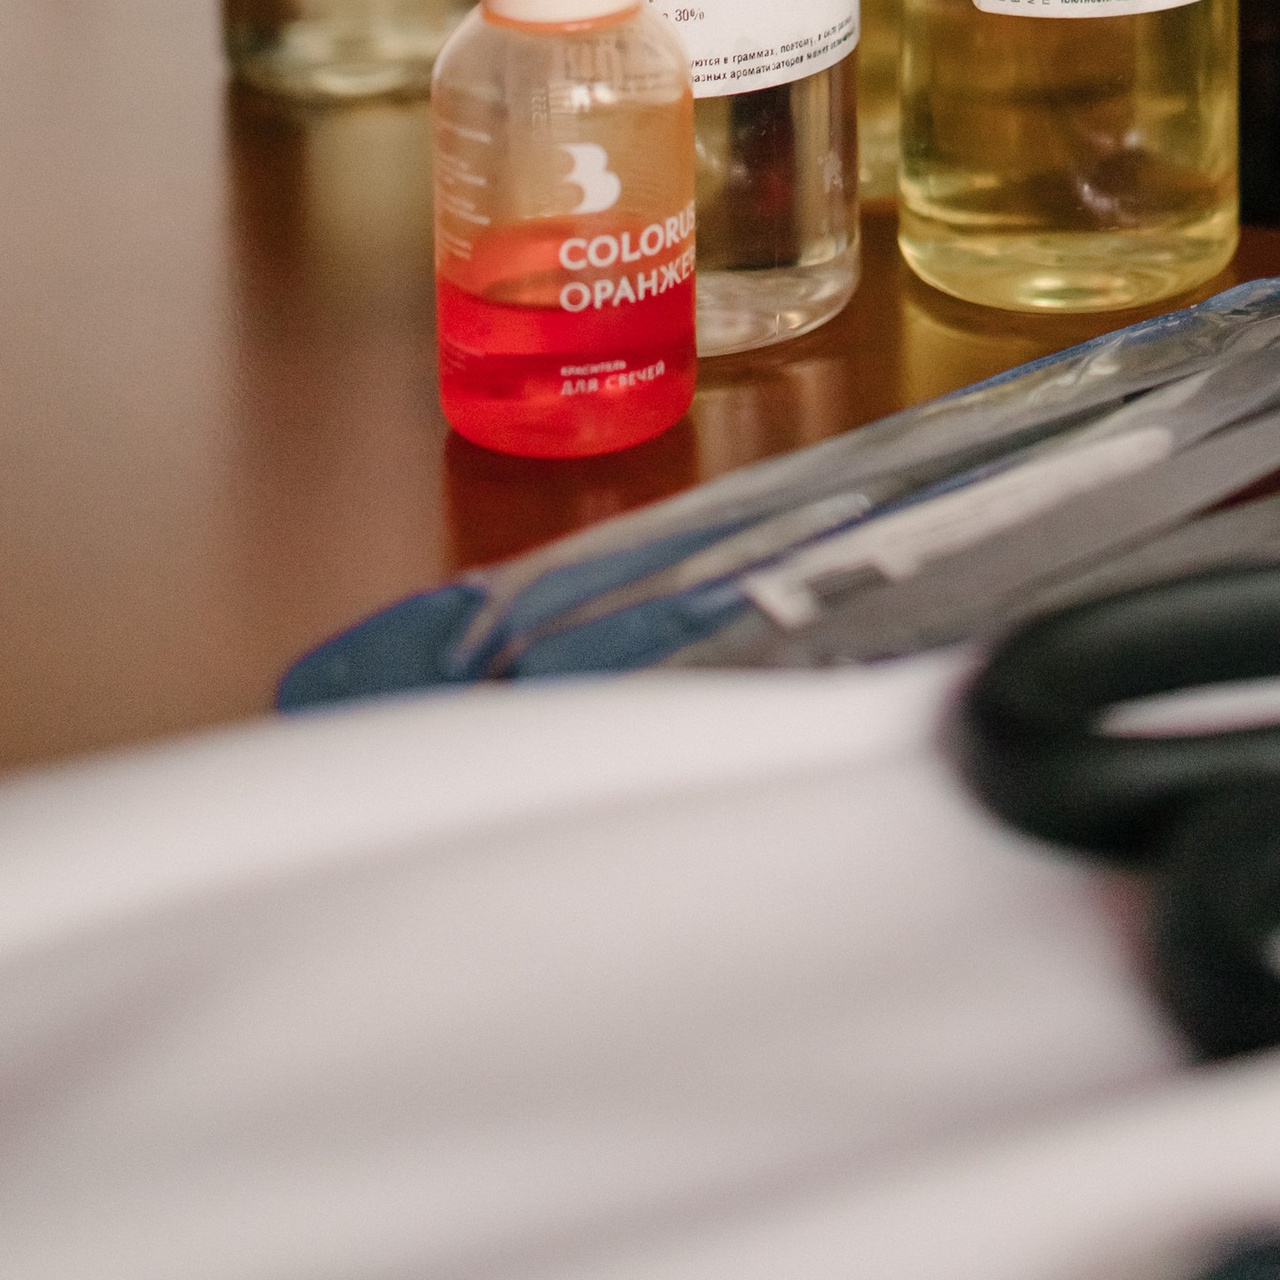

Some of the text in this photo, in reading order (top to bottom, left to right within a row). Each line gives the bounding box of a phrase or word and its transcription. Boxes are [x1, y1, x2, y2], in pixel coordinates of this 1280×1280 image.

[675, 8, 705, 22] 30%
[560, 359, 666, 396] ДЛЯ СВЕЧЕЙ
